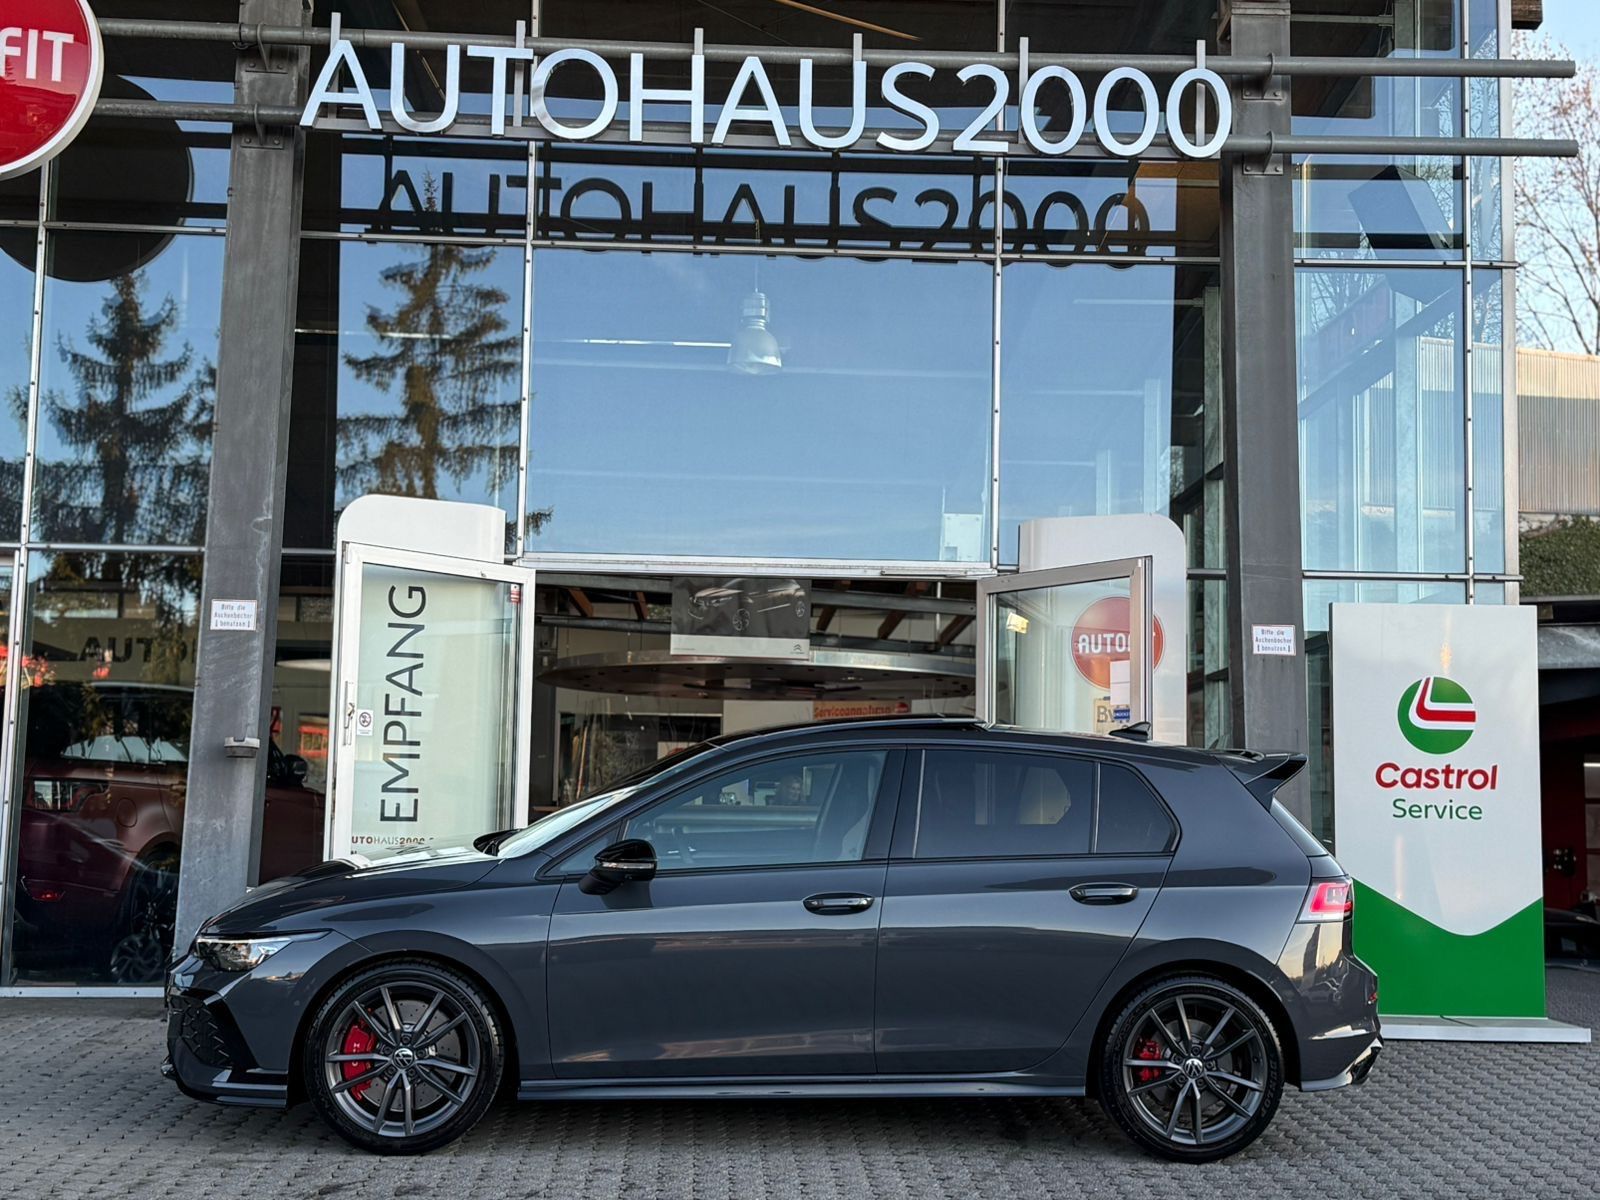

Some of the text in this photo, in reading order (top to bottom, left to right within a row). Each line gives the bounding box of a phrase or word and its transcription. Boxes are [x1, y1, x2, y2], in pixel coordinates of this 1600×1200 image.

[300, 40, 1231, 158] AUTOHAUS2000
[380, 584, 426, 821] EMPFANG
[1375, 762, 1498, 790] Castrol
[1392, 799, 1483, 820] Service
